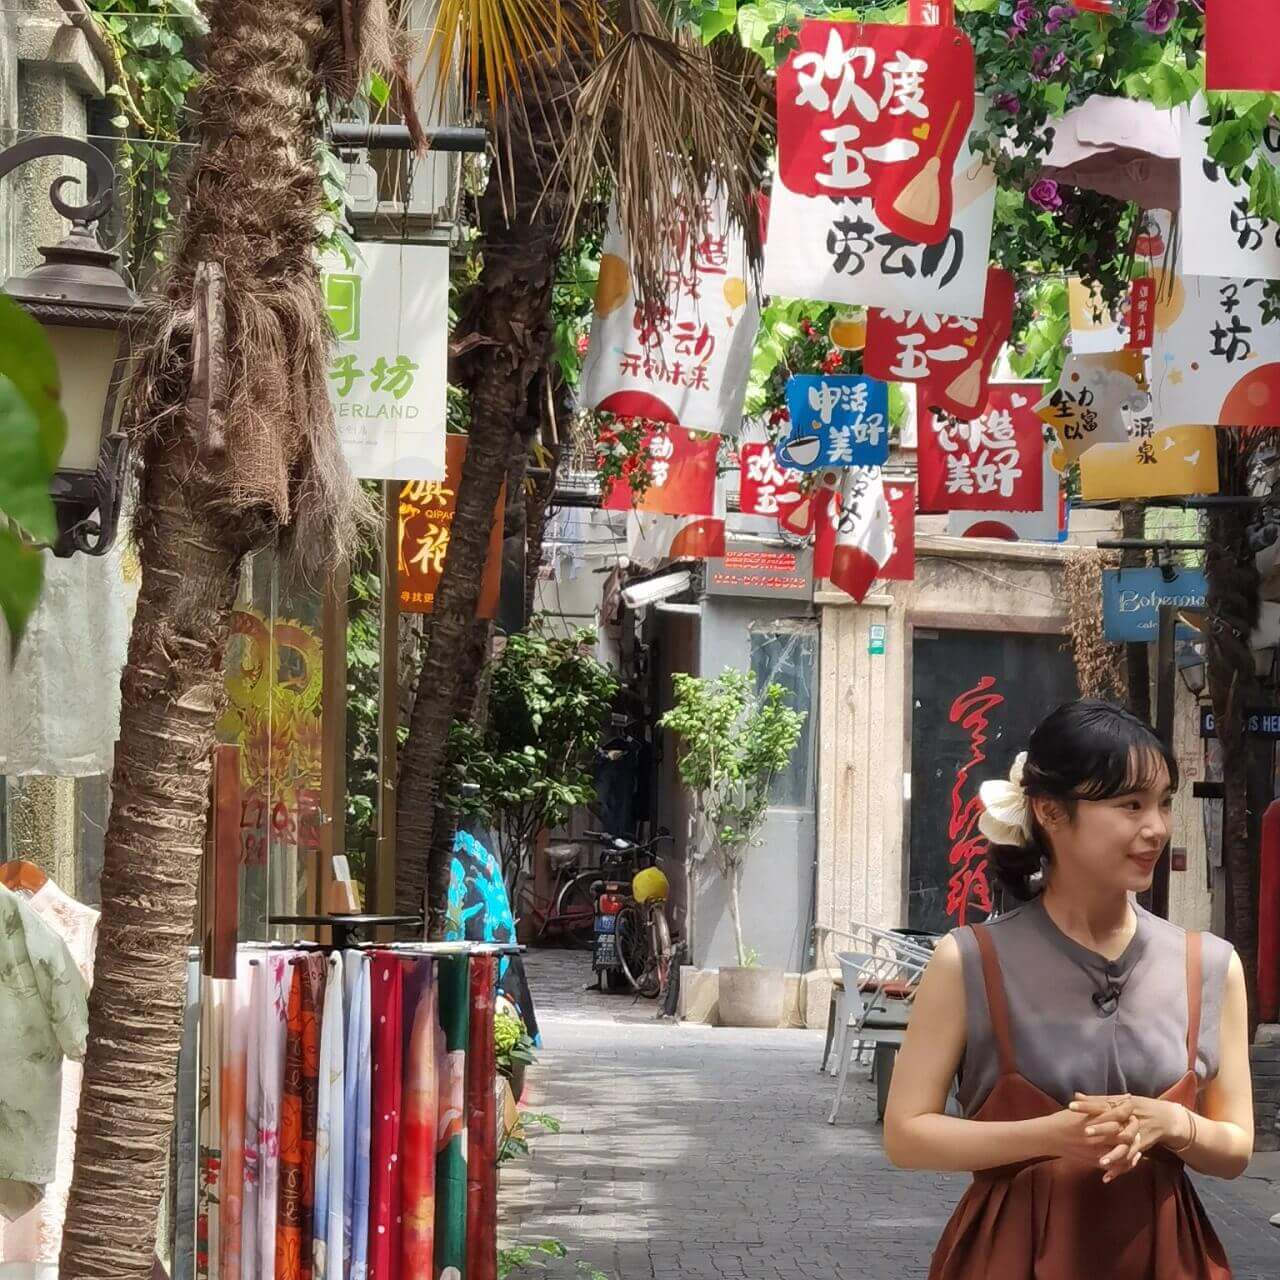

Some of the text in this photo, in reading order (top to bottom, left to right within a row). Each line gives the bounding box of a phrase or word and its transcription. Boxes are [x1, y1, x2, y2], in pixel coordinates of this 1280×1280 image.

[792, 28, 930, 122] 欢度
[815, 124, 920, 189] 五一
[889, 333, 968, 378] 五一
[334, 402, 420, 420] ERLAND
[945, 448, 1023, 498] 美好
[754, 485, 802, 513] 五一
